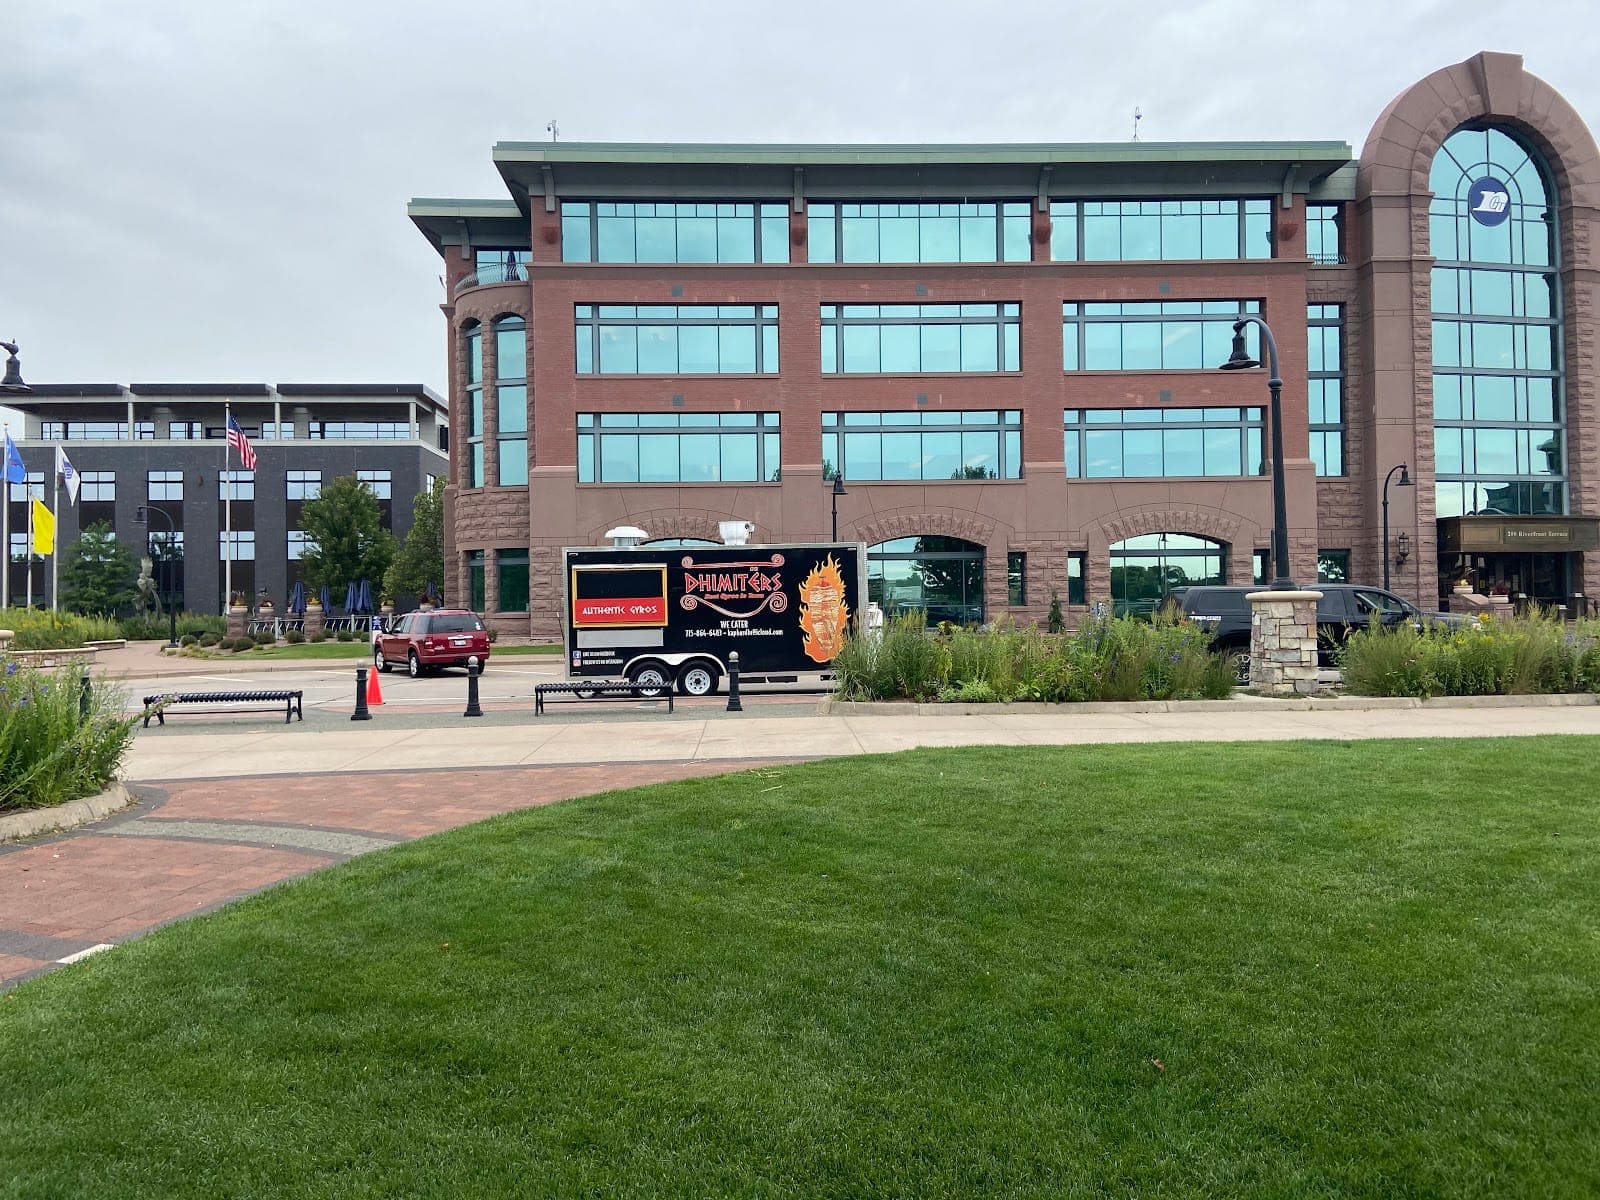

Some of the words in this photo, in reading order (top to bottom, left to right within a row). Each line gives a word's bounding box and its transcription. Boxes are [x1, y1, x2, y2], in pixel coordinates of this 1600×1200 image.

[582, 606, 626, 615] AUTHENTIC
[630, 605, 658, 614] GYROS
[720, 620, 731, 629] WE
[731, 620, 748, 629] CATER
